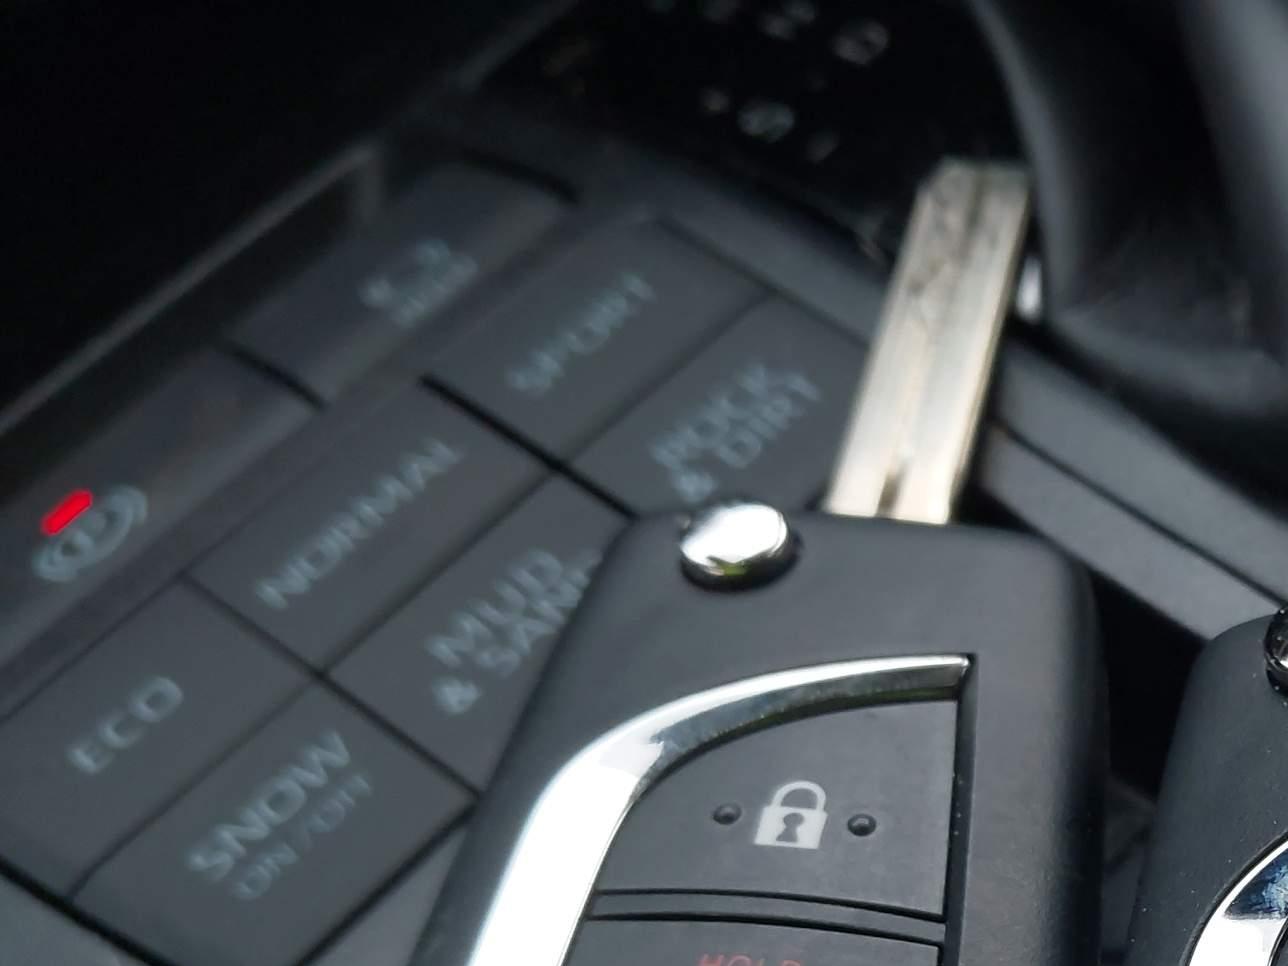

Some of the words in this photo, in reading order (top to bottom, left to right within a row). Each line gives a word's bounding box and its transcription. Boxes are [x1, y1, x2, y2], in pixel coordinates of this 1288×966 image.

[255, 438, 460, 608] NORMAL
[425, 550, 562, 665] MUD
[67, 675, 183, 774] ECO
[186, 730, 350, 882] SNOW
